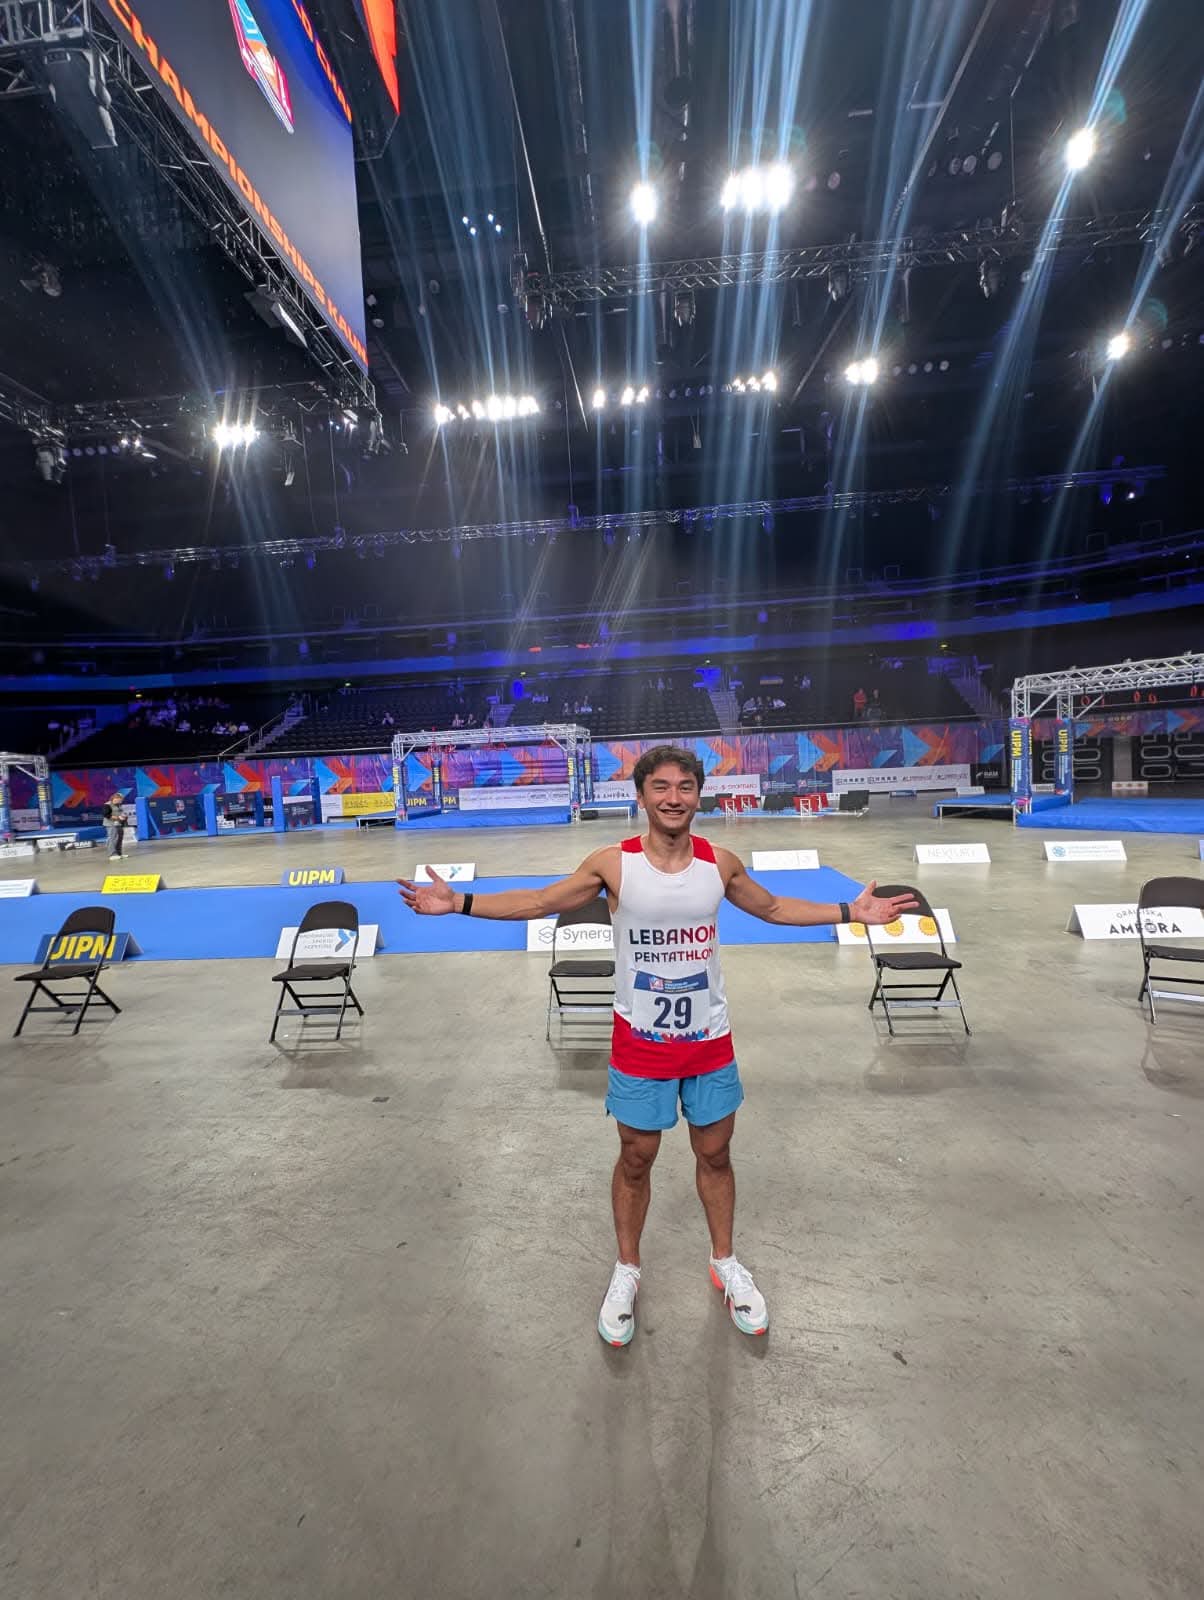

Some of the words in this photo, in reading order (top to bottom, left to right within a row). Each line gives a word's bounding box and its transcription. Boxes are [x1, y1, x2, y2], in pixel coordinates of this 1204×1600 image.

[108, 0, 326, 306] CHAMPIONSHIPS
[1011, 730, 1022, 757] UIPM
[1059, 729, 1068, 752] UIPM
[289, 869, 335, 885] UIPM
[629, 924, 715, 945] LEBANON
[48, 935, 116, 960] UIPM
[634, 946, 713, 962] PENTATHLON
[653, 996, 692, 1029] 29
